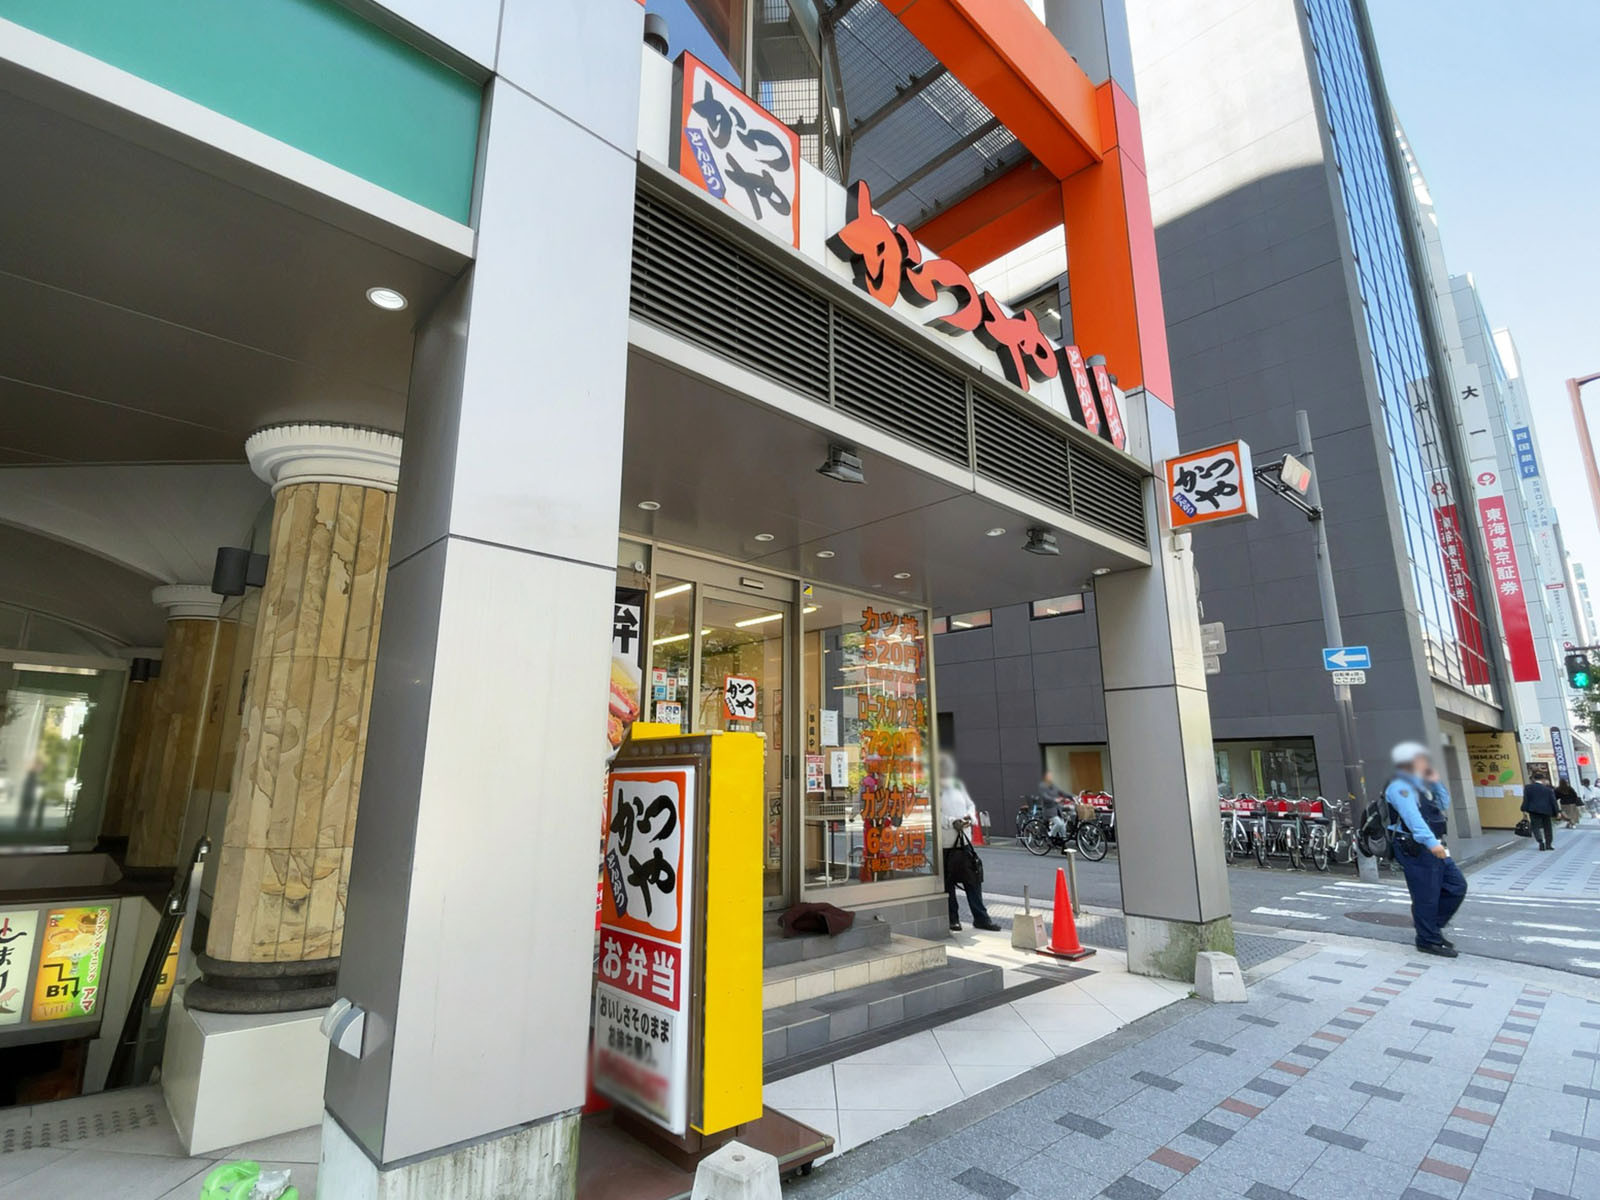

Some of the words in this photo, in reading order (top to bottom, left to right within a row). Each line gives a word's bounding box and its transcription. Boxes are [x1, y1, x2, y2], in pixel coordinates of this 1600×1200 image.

[689, 131, 720, 191] とんかつ
[691, 80, 791, 221] かつや
[827, 179, 1058, 392] かつや
[1068, 349, 1097, 427] とんかつ
[1516, 432, 1535, 474] 四国銀行
[1174, 458, 1238, 509] かつや
[1485, 508, 1519, 596] 東海東京証券
[860, 606, 919, 641] カツ丼
[864, 636, 920, 672] 520円
[727, 680, 754, 714] かつや
[861, 784, 928, 819] カツカレー
[610, 788, 677, 917] かつや
[867, 825, 927, 854] 690円
[607, 855, 625, 908] とんかつ
[46, 984, 68, 997] B1
[602, 936, 675, 1002] お弁当
[601, 996, 670, 1043] おいしさそのまま
